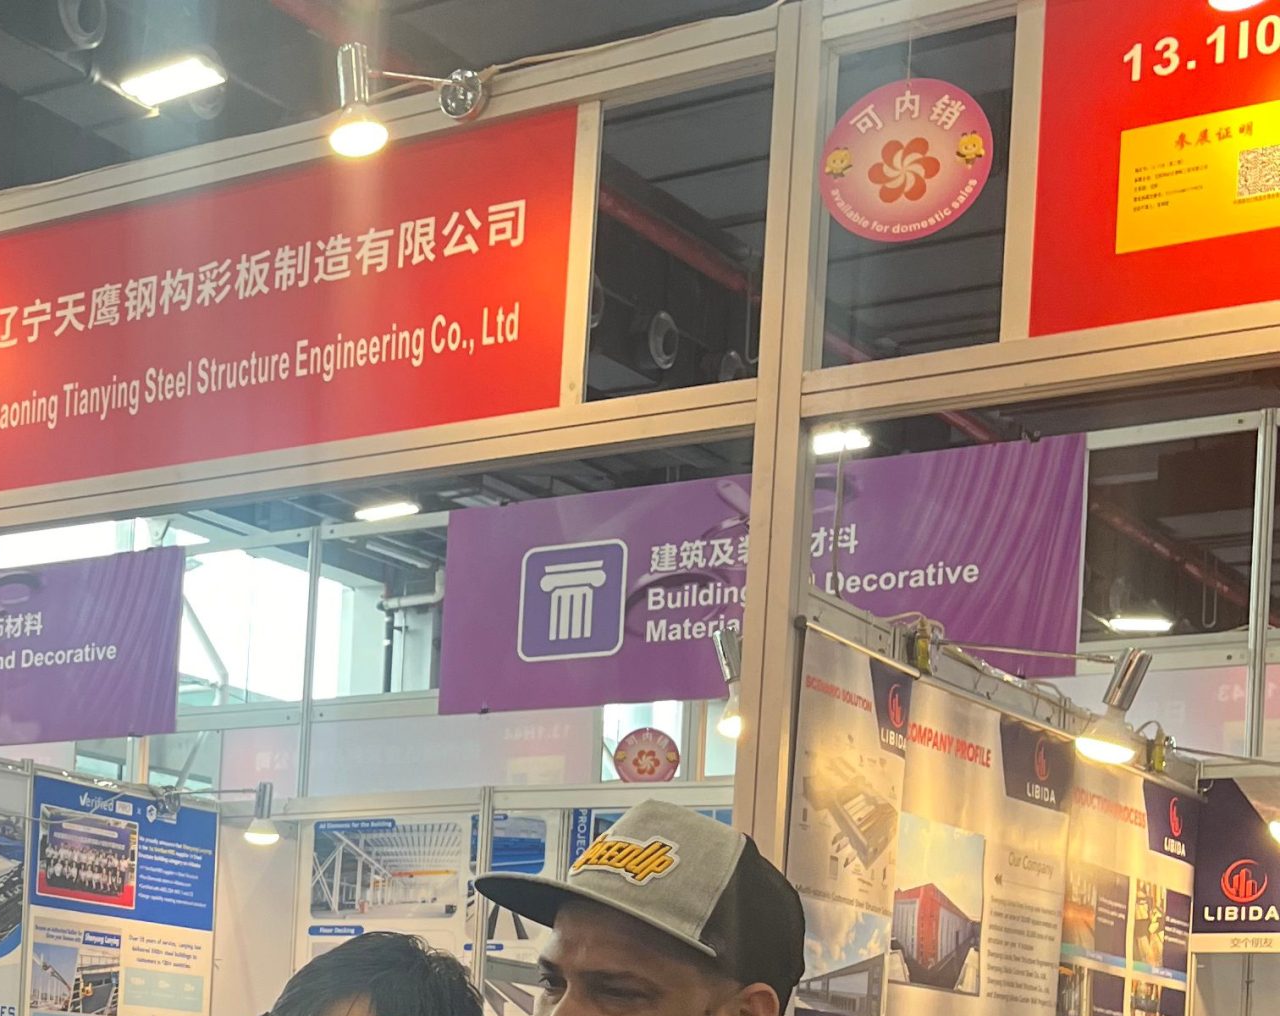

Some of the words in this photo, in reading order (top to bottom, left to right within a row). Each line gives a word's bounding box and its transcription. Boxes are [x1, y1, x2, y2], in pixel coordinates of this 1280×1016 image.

[849, 90, 966, 134] 可内销
[831, 188, 869, 228] available
[871, 222, 889, 233] for
[892, 206, 952, 234] domestic
[951, 178, 978, 209] sales
[63, 376, 140, 420] Tianying
[145, 367, 192, 402] Steel
[197, 349, 290, 393] Structure
[295, 322, 426, 383] Engineering
[430, 313, 475, 356] Co.,
[481, 301, 520, 346] Ltd
[825, 561, 979, 595] Decorative
[646, 614, 743, 643] Materi
[20, 642, 117, 669] Decorative
[955, 737, 992, 768] PROFILE
[1026, 782, 1056, 805] LIBIDA
[575, 809, 588, 856] PROJEC
[1164, 836, 1186, 857] LIBIDA
[1008, 851, 1021, 867] Our
[1022, 855, 1054, 879] Company
[1204, 905, 1280, 921] LIBIDA
